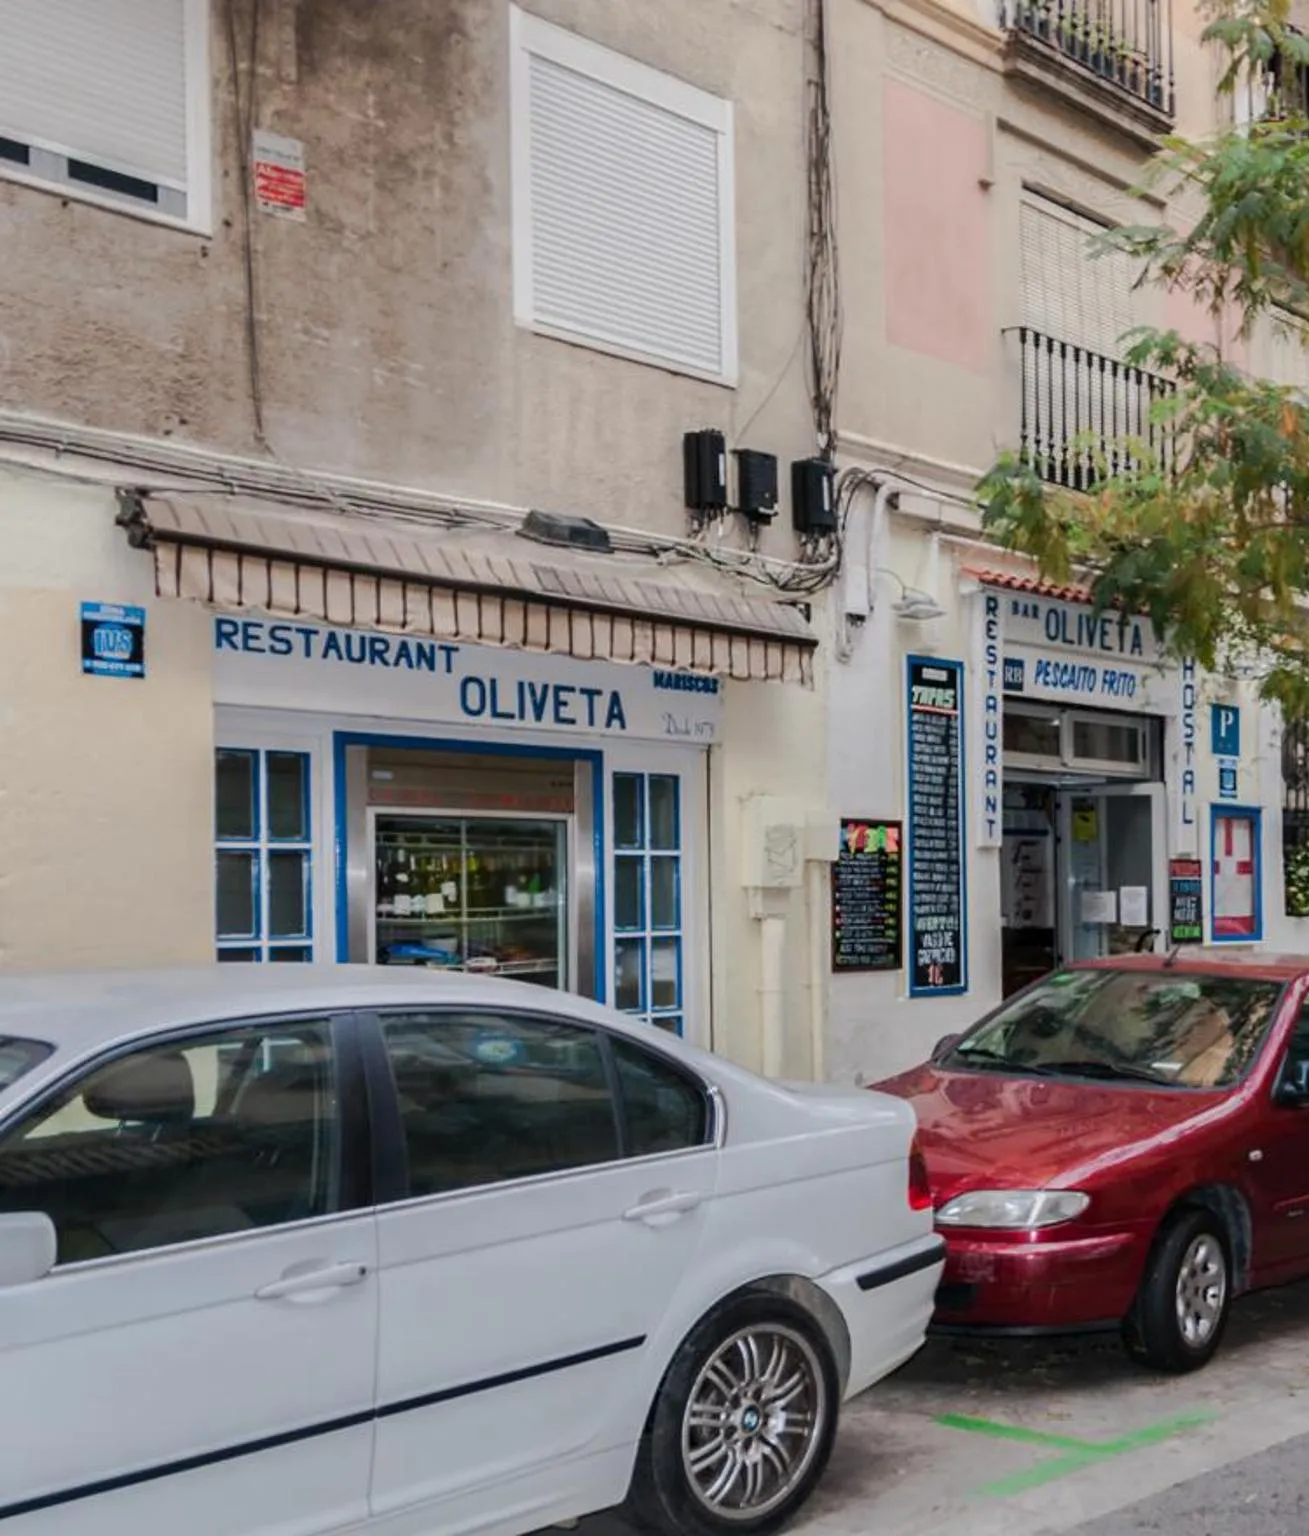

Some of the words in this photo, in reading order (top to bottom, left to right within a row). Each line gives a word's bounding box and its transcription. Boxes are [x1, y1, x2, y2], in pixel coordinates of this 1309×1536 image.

[215, 618, 460, 673] RESTAURANT
[1012, 601, 1040, 619] BAR
[1045, 607, 1143, 657] OLIVETA
[653, 670, 719, 694] MARISCOS
[1003, 665, 1023, 684] RB
[1034, 659, 1097, 693] PESCAITO
[1102, 669, 1137, 698] FRITO
[460, 675, 627, 731] OLIVETA
[985, 597, 999, 839] RESTAURANT
[1219, 710, 1235, 738] P
[1182, 656, 1196, 825] HOSTAL
